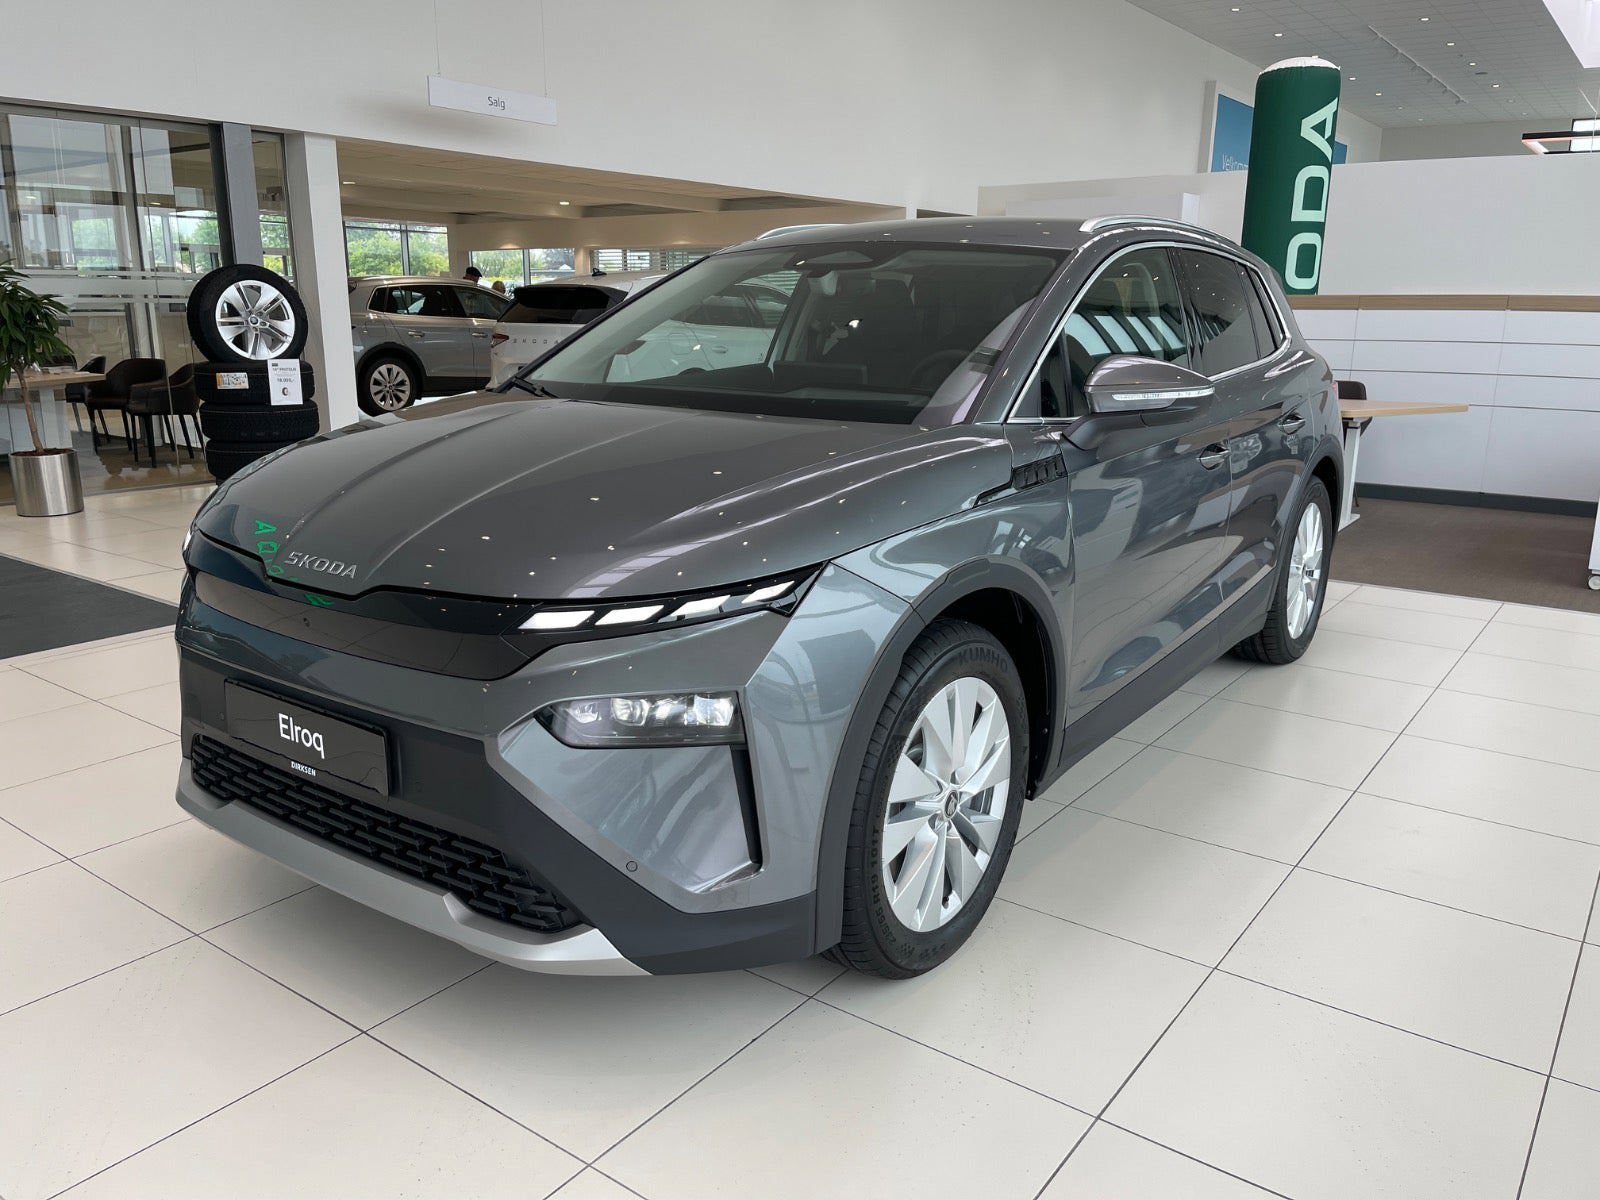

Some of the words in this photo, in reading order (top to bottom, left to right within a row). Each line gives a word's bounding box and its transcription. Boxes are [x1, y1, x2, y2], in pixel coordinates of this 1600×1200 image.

[487, 96, 506, 111] Salg
[284, 551, 358, 579] SKODA
[958, 646, 1008, 673] KUMHO
[278, 712, 325, 760] Elroq
[290, 761, 317, 777] DIRKSEN
